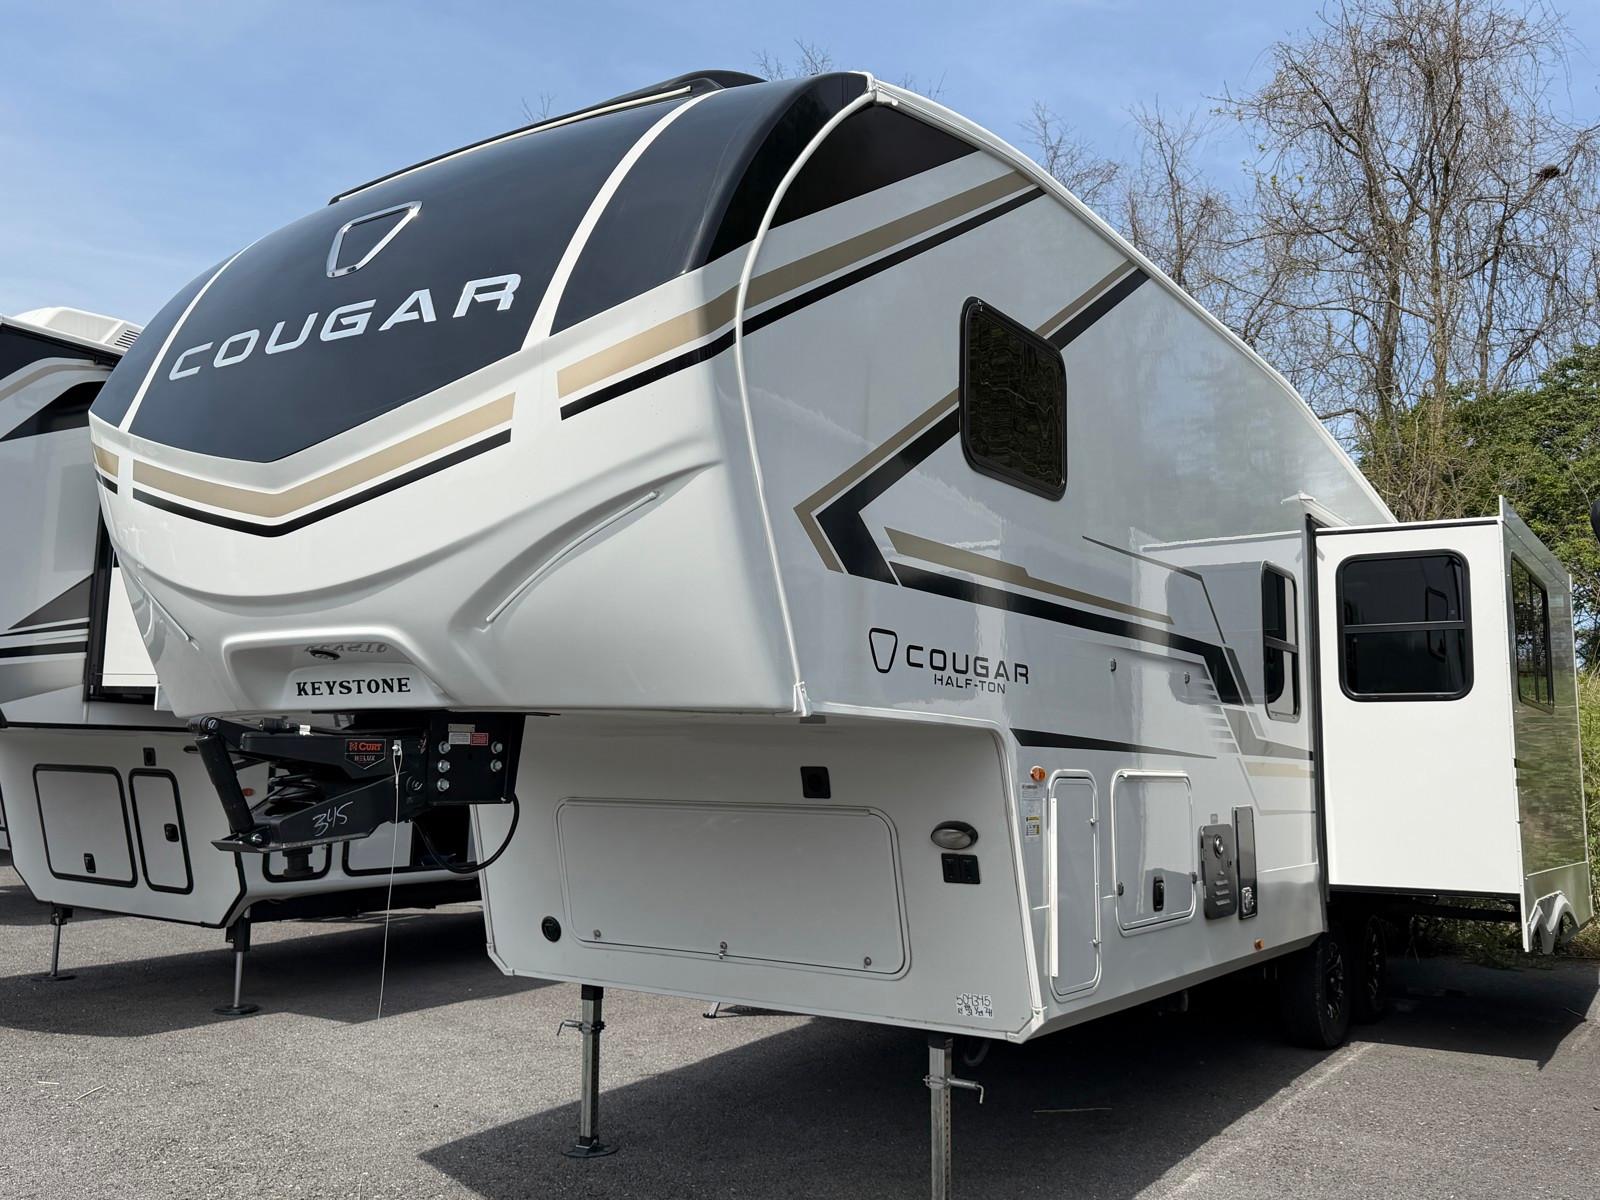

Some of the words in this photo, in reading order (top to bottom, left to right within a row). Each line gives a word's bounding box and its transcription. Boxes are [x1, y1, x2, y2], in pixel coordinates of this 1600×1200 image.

[168, 273, 521, 381] COUGAR
[906, 644, 1029, 685] COUGAR
[295, 677, 411, 697] KEYSTONE
[933, 673, 1006, 694] HALF-TON
[312, 801, 354, 837] 345
